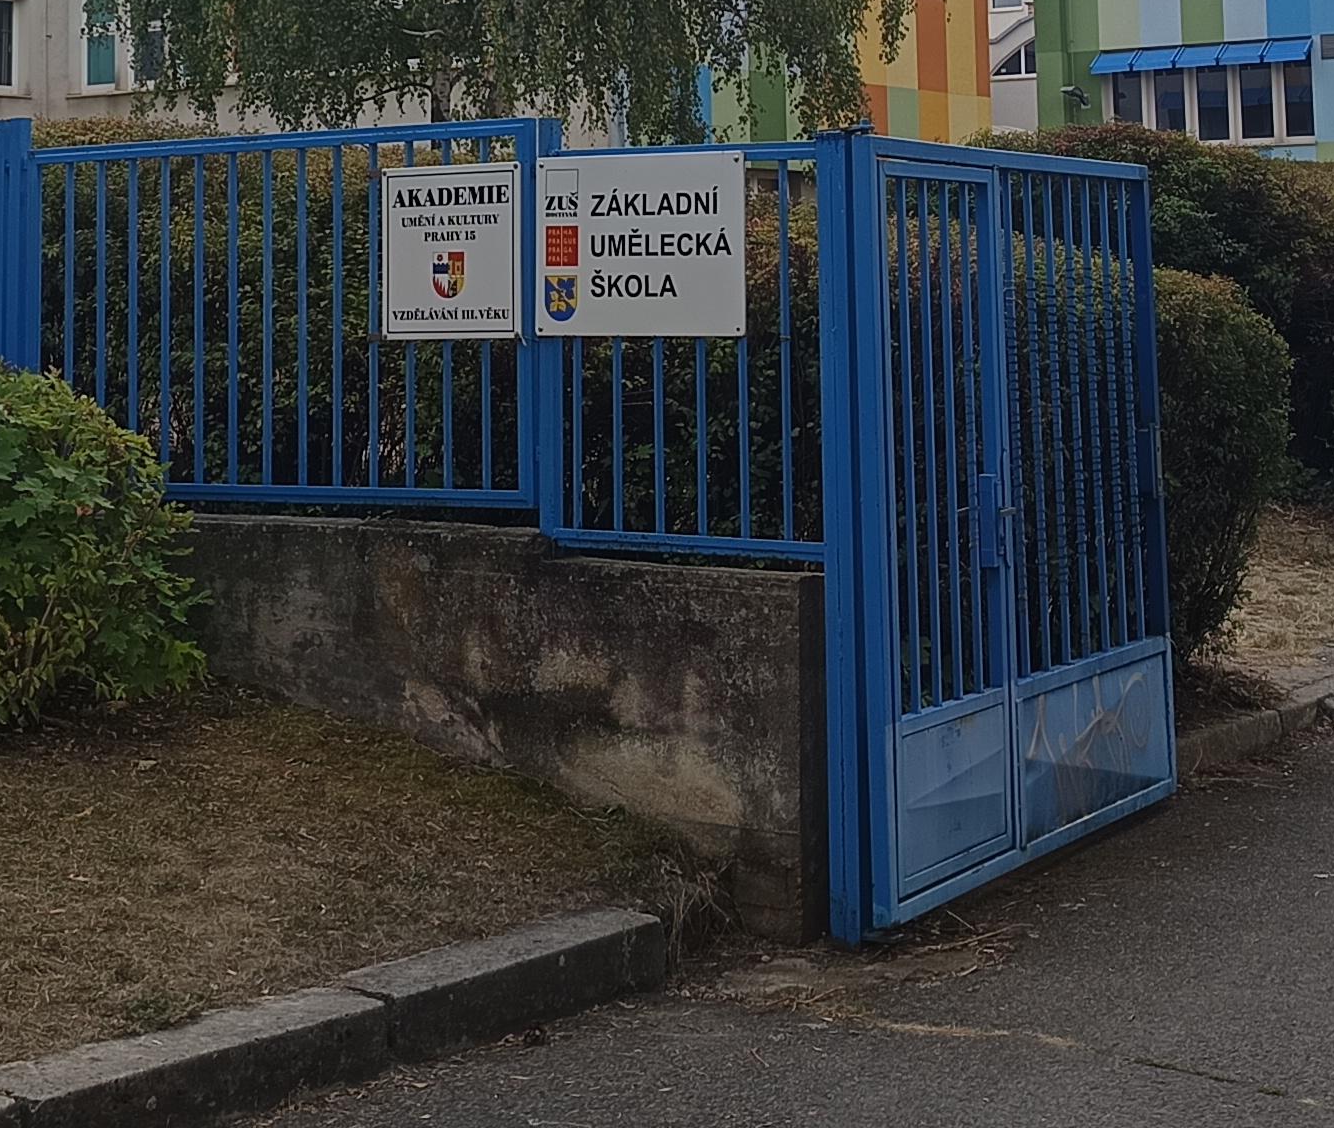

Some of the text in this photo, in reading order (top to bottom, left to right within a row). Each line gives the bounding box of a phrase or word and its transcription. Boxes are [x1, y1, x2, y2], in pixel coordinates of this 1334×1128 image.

[392, 185, 509, 208] AKADEMIE
[545, 192, 578, 210] ZUŠ
[590, 185, 718, 216] ZÁKLADNÍ
[401, 213, 499, 228] UMĚNÍ A KULTURY
[424, 231, 476, 242] PRAHY 15
[590, 227, 732, 257] UMĚLECKÁ
[590, 269, 678, 298] ŠKOLA
[392, 307, 458, 320] VZDĚLÁVÁNÍ
